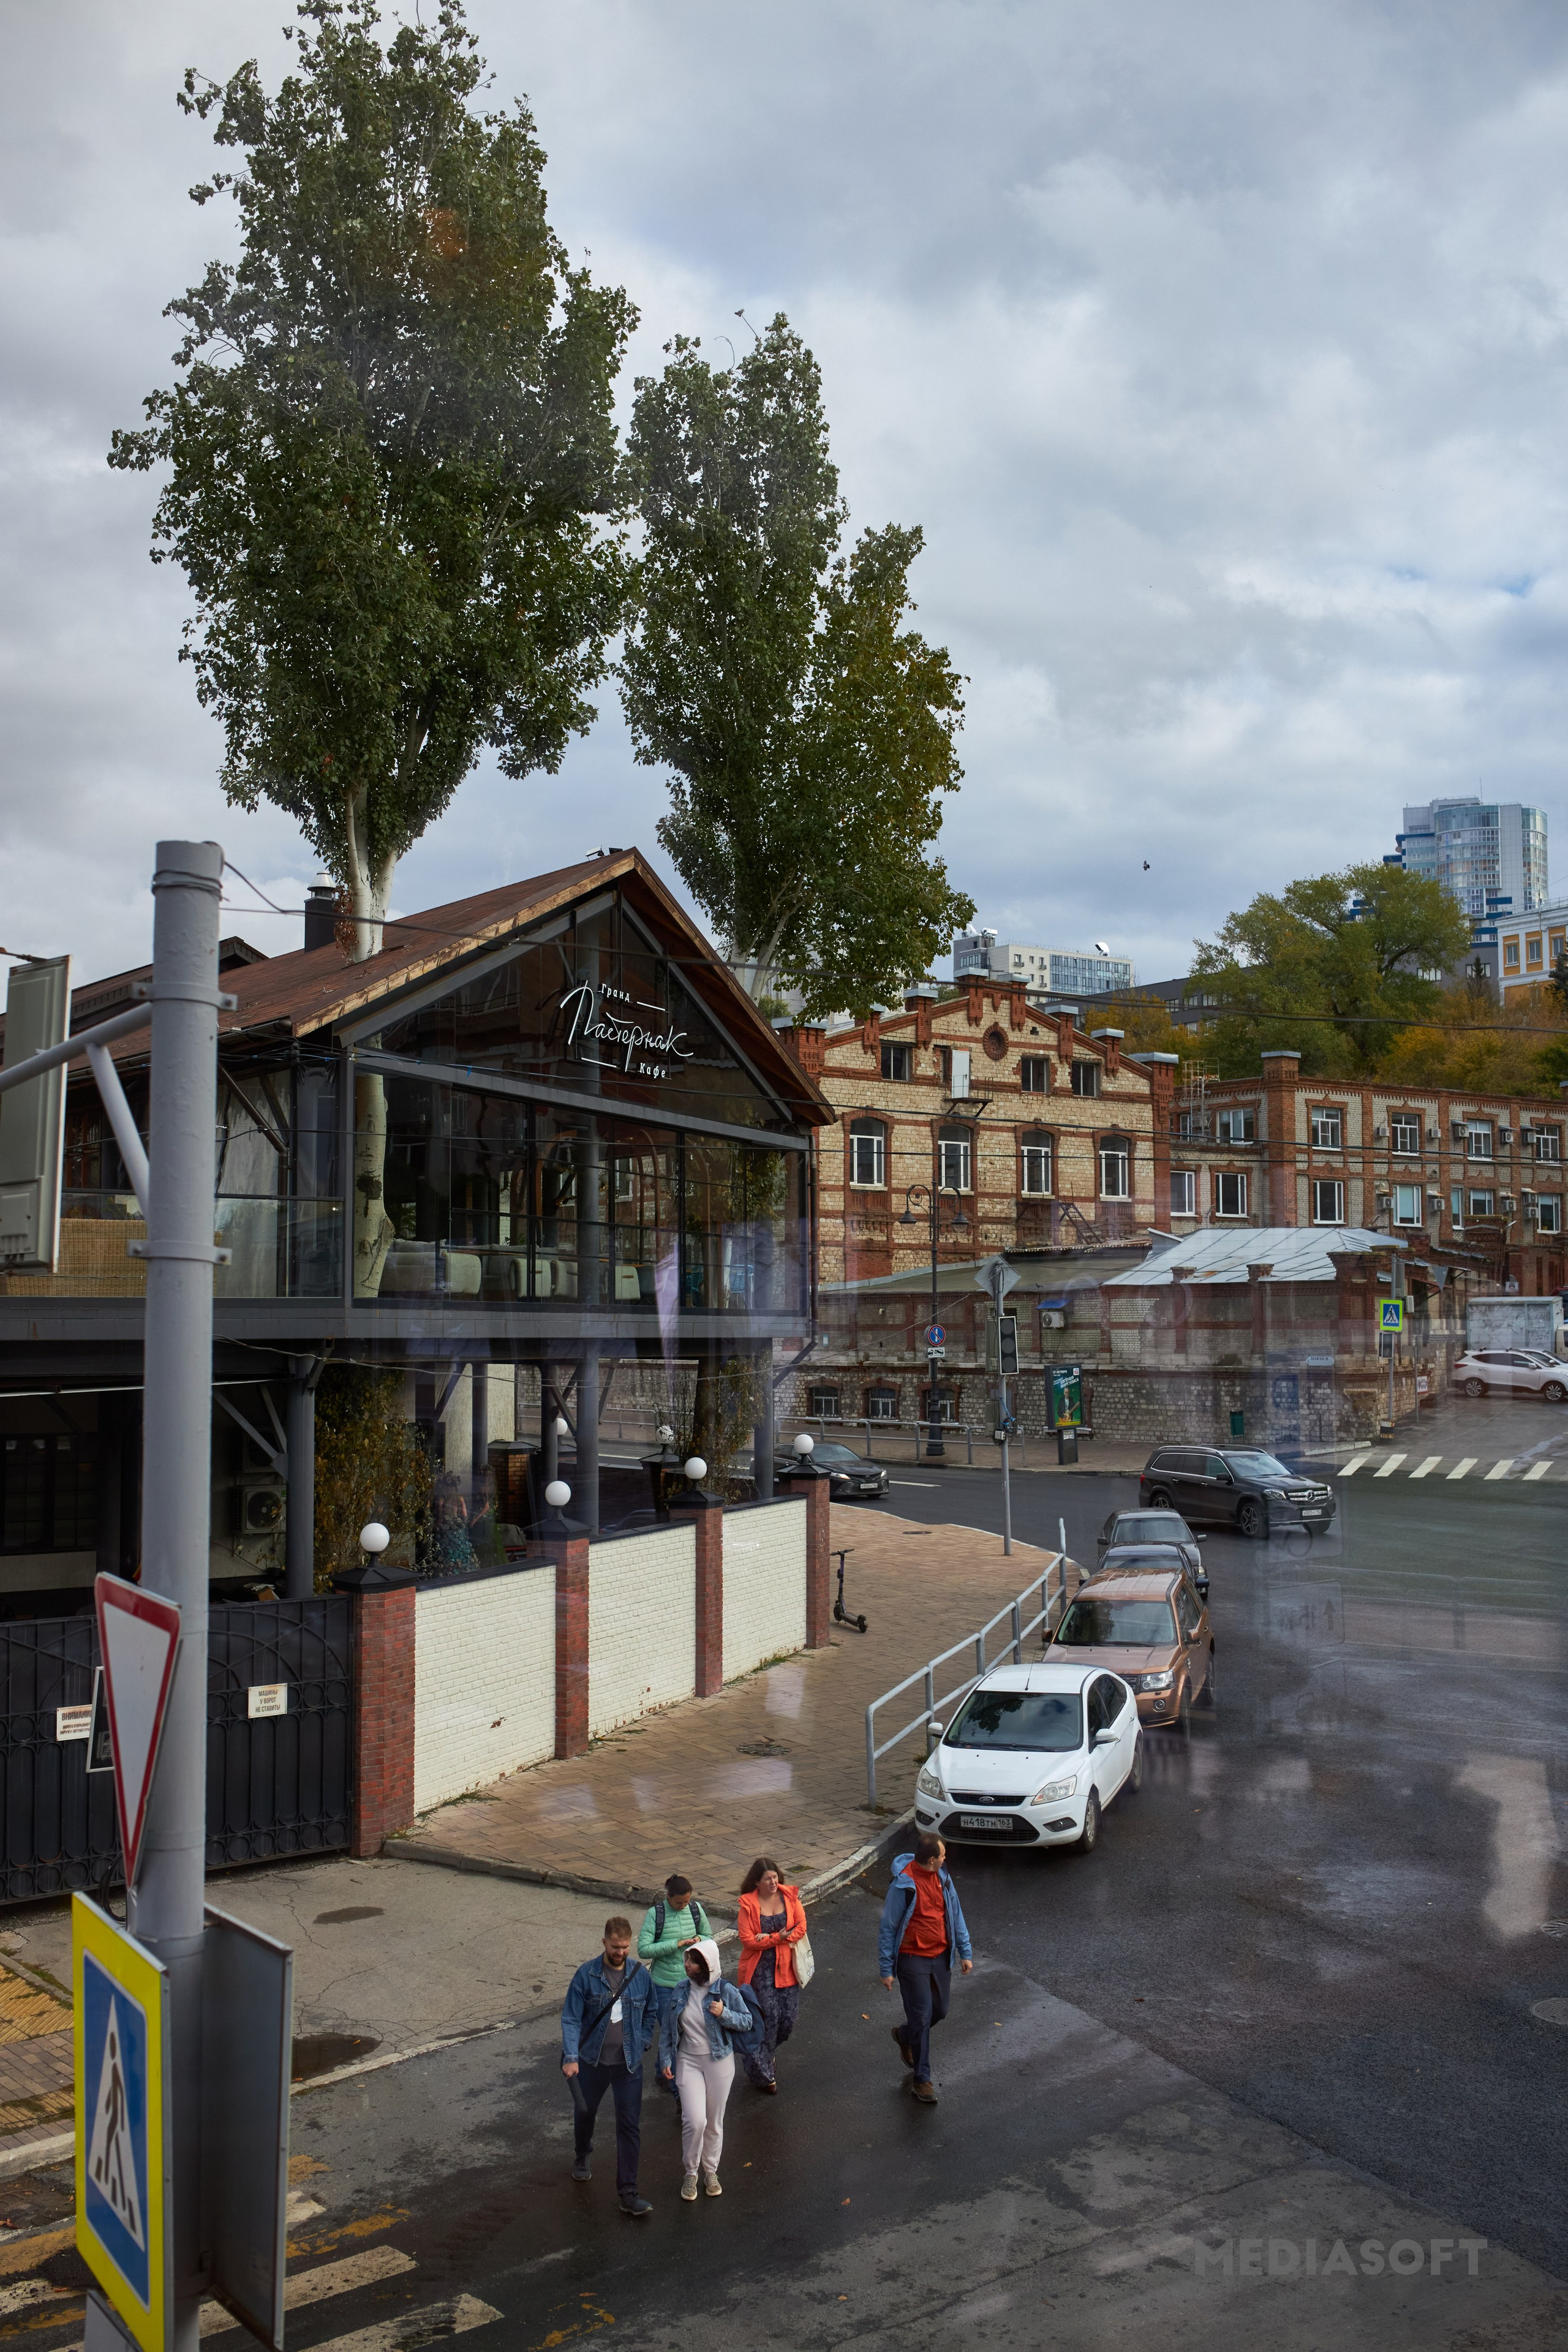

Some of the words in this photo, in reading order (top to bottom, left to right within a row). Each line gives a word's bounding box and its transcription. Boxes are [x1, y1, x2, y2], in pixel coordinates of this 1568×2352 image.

[601, 983, 630, 1003] Гранд
[560, 979, 694, 1072] Пастернак
[639, 1062, 665, 1079] Кафе
[963, 1818, 996, 1827] Н418ТН
